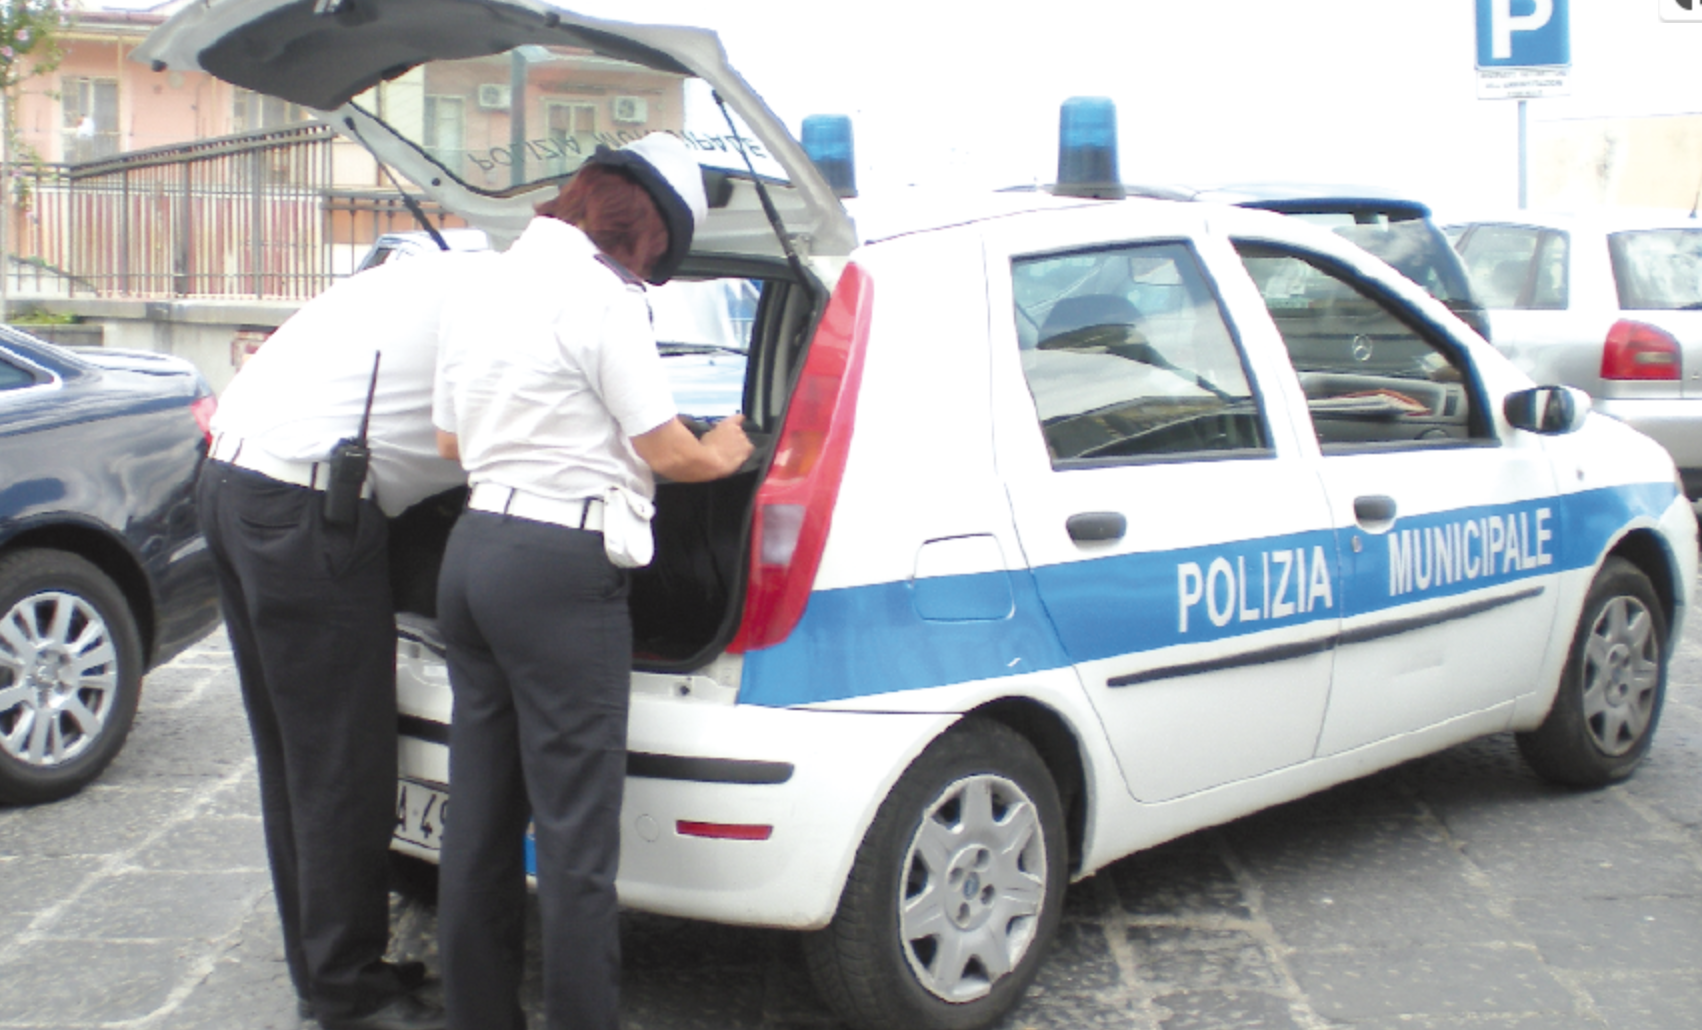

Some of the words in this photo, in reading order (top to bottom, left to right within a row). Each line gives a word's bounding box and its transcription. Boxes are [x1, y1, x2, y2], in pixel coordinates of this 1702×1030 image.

[1491, 0, 1553, 59] P
[1177, 545, 1333, 633] POLIZIA
[1388, 508, 1552, 597] MUNICIPALE
